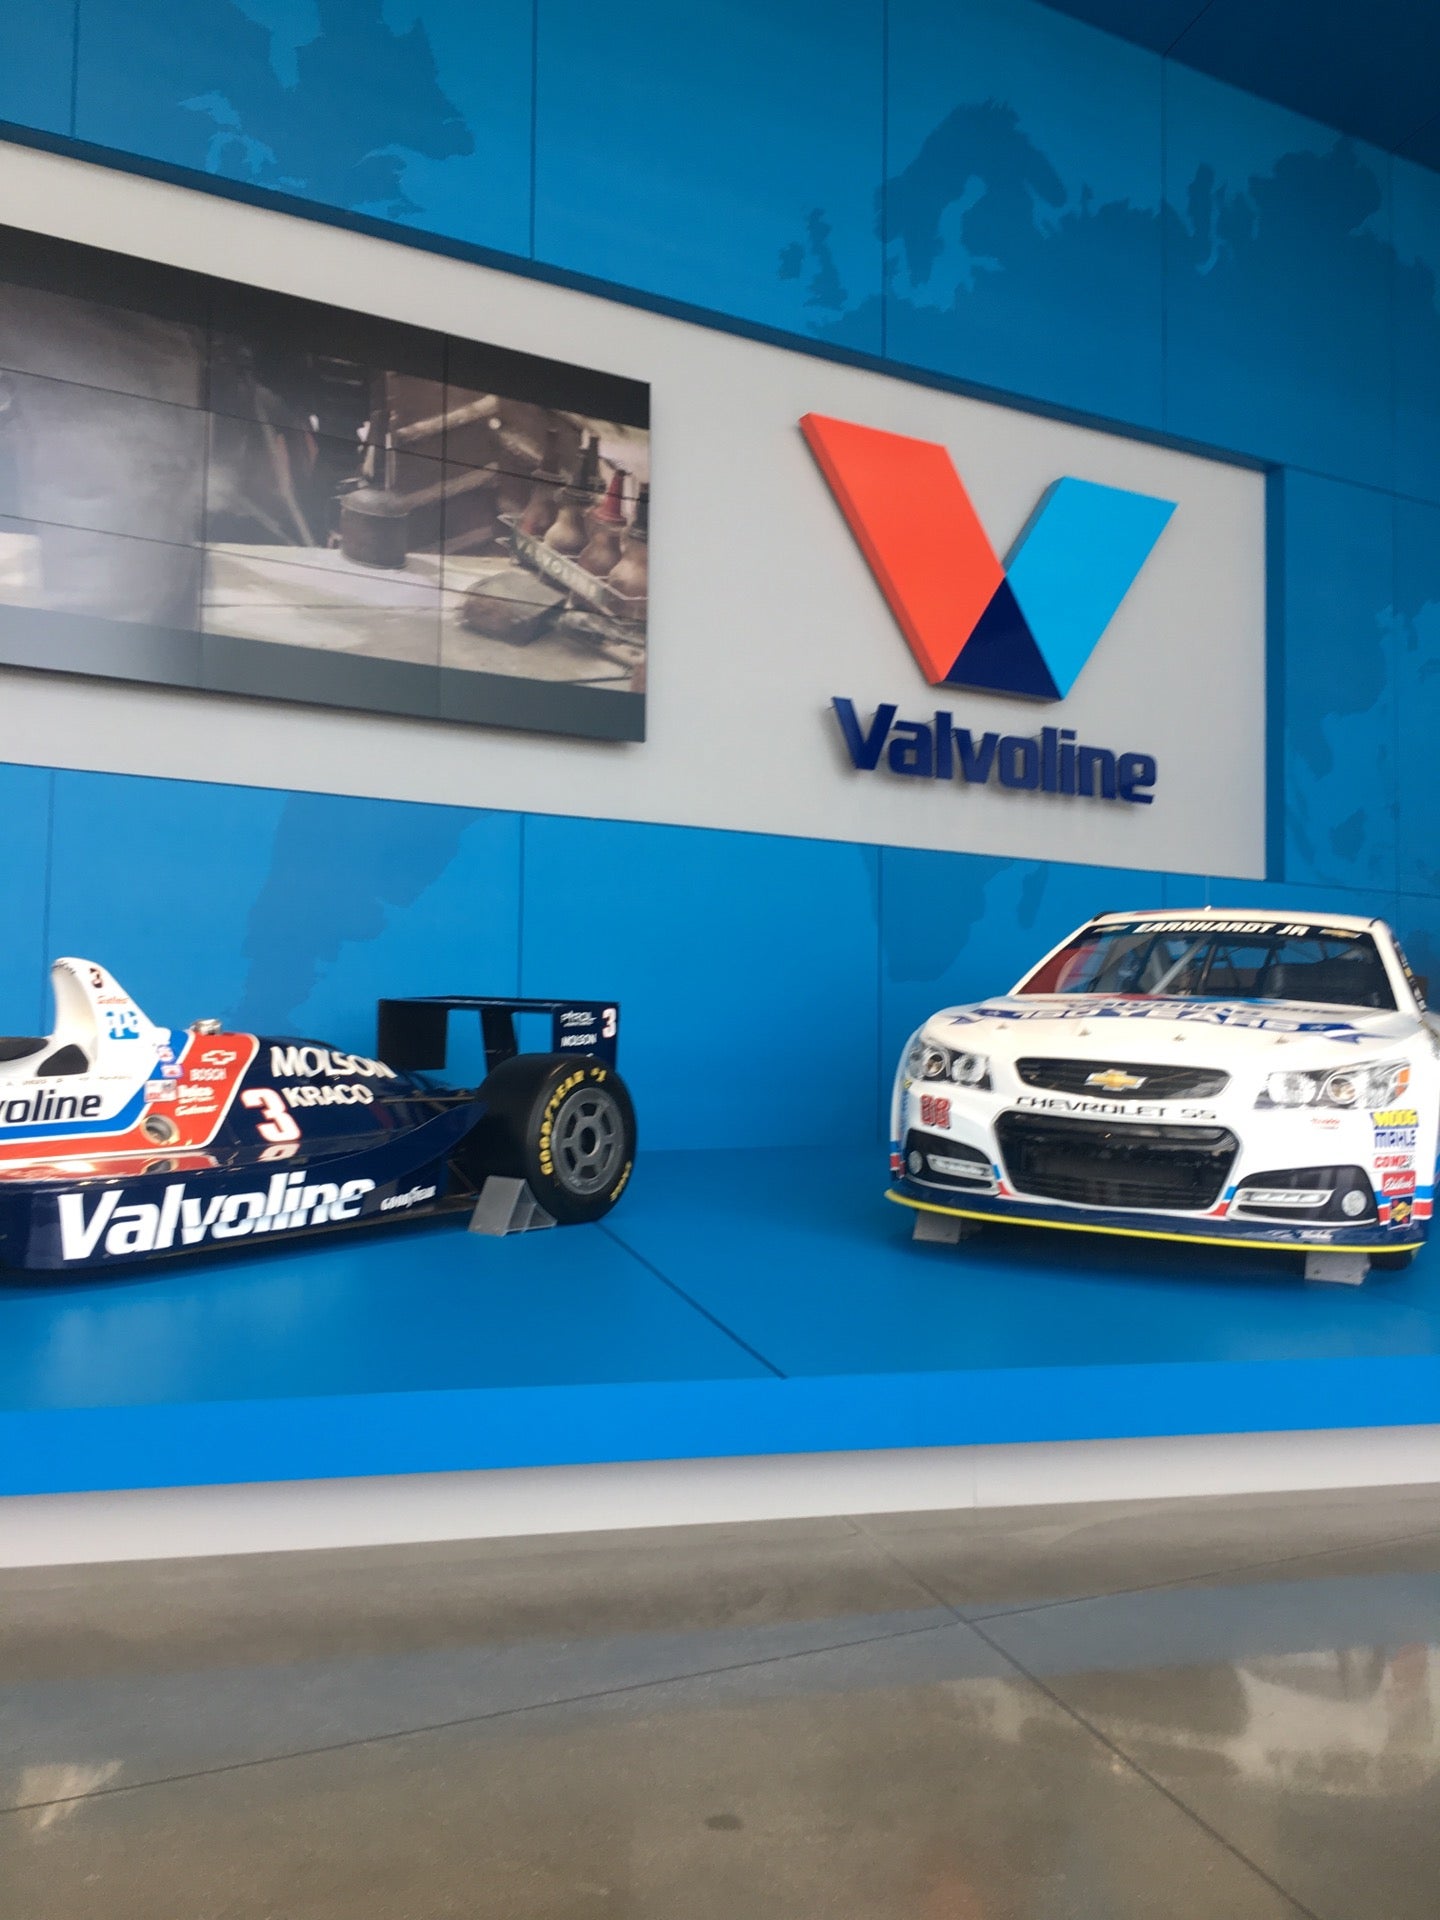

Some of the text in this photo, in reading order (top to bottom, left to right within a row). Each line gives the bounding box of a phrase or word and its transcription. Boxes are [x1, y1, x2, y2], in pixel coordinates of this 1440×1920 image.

[831, 696, 1158, 805] Valvoline
[1132, 920, 1311, 937] EARNHARDT JR
[602, 1007, 617, 1038] 3
[561, 1032, 598, 1048] MOLSON
[270, 1045, 398, 1079] MOLSON
[281, 1083, 374, 1108] KRACO
[1015, 1096, 1217, 1119] CHEVROLET SS
[240, 1087, 302, 1143] 3
[1371, 1108, 1418, 1130] MOOG
[57, 1170, 376, 1261] Valvoline
